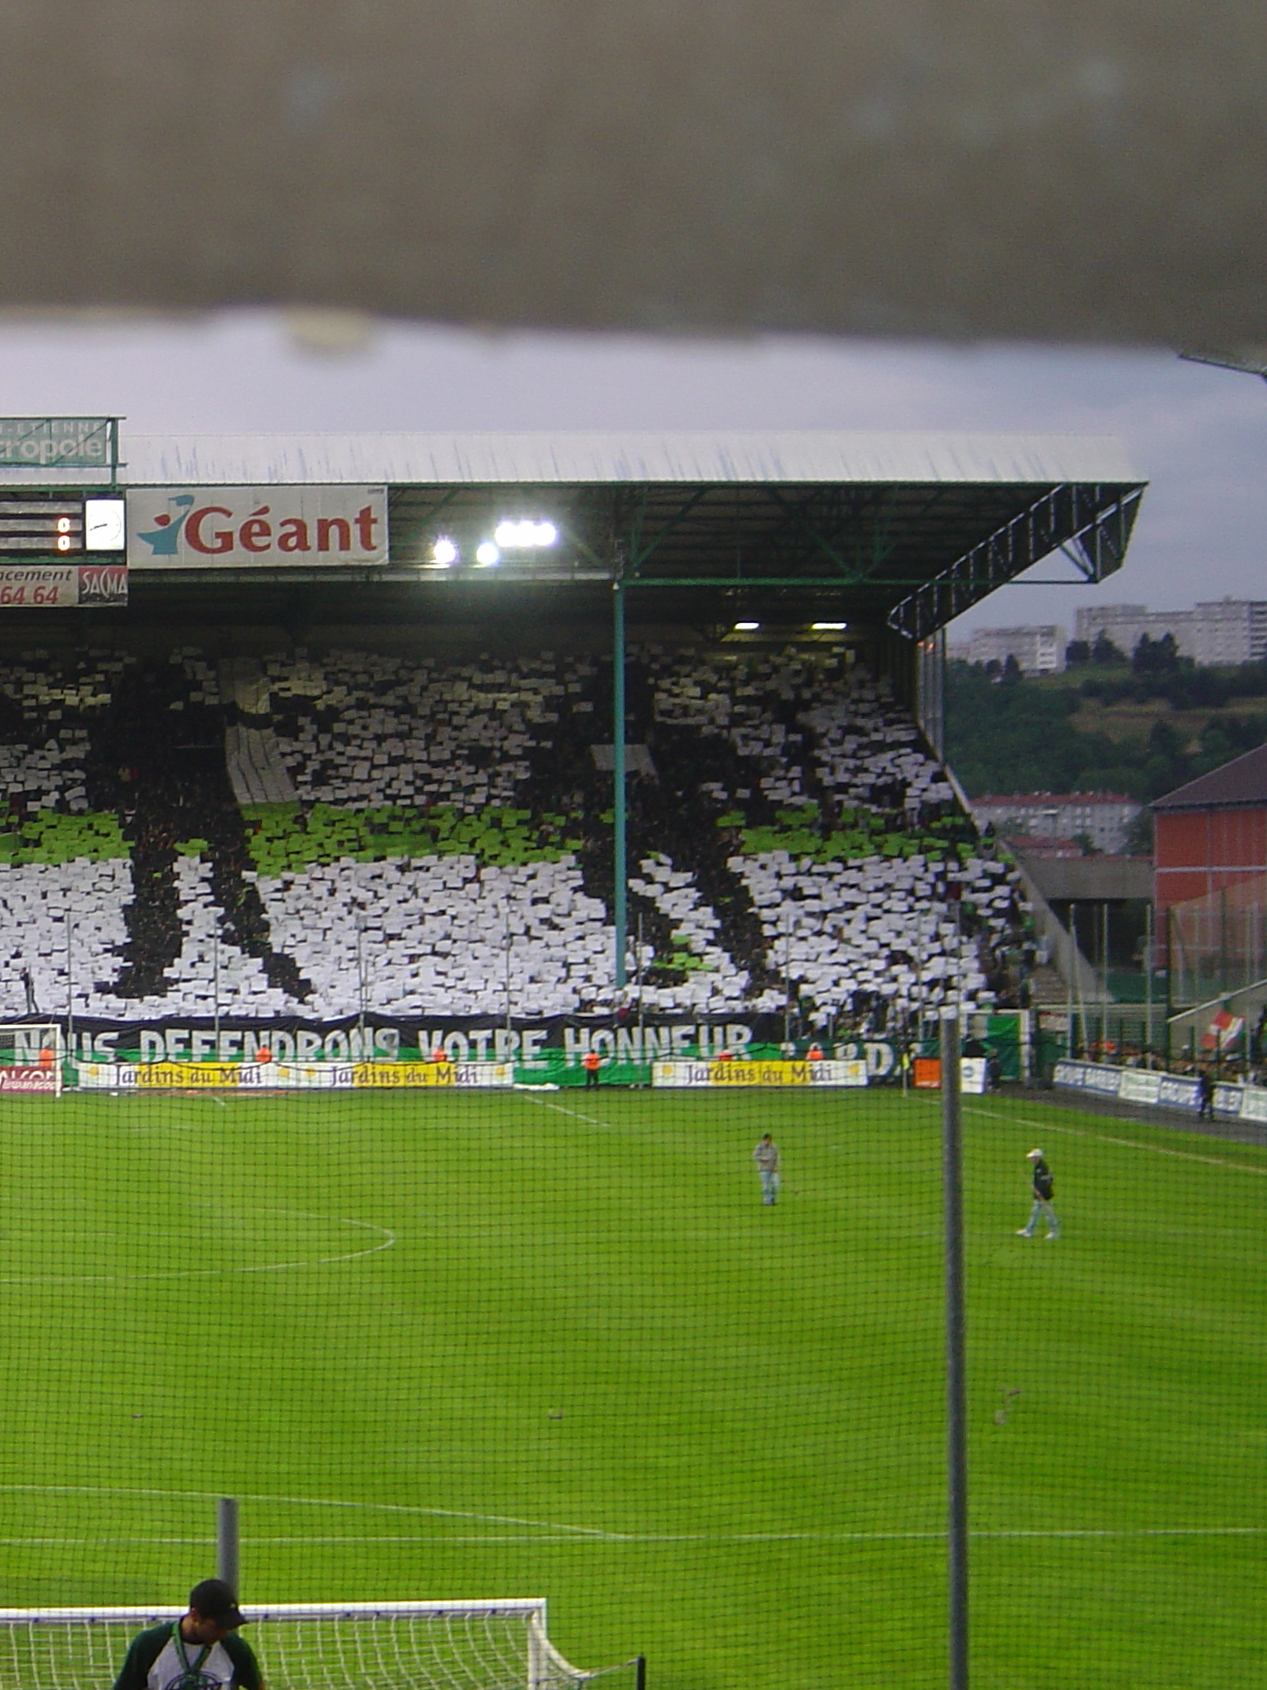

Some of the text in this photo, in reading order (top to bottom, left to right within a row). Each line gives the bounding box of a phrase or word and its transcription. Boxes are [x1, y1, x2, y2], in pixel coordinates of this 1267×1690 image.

[58, 517, 70, 533] 0
[185, 505, 378, 554] Géant
[58, 535, 70, 551] 0
[81, 568, 128, 598] SACMA
[0, 586, 26, 604] 64
[33, 586, 59, 604] 64
[140, 1028, 399, 1063] DEFENDRONS
[418, 1028, 548, 1069] VOTRE
[564, 1024, 753, 1069] HONNEUR
[114, 1066, 262, 1085] Jardins du Midi
[332, 1066, 478, 1085] Jardins du Midi
[686, 1063, 832, 1085] Jardins du Midi
